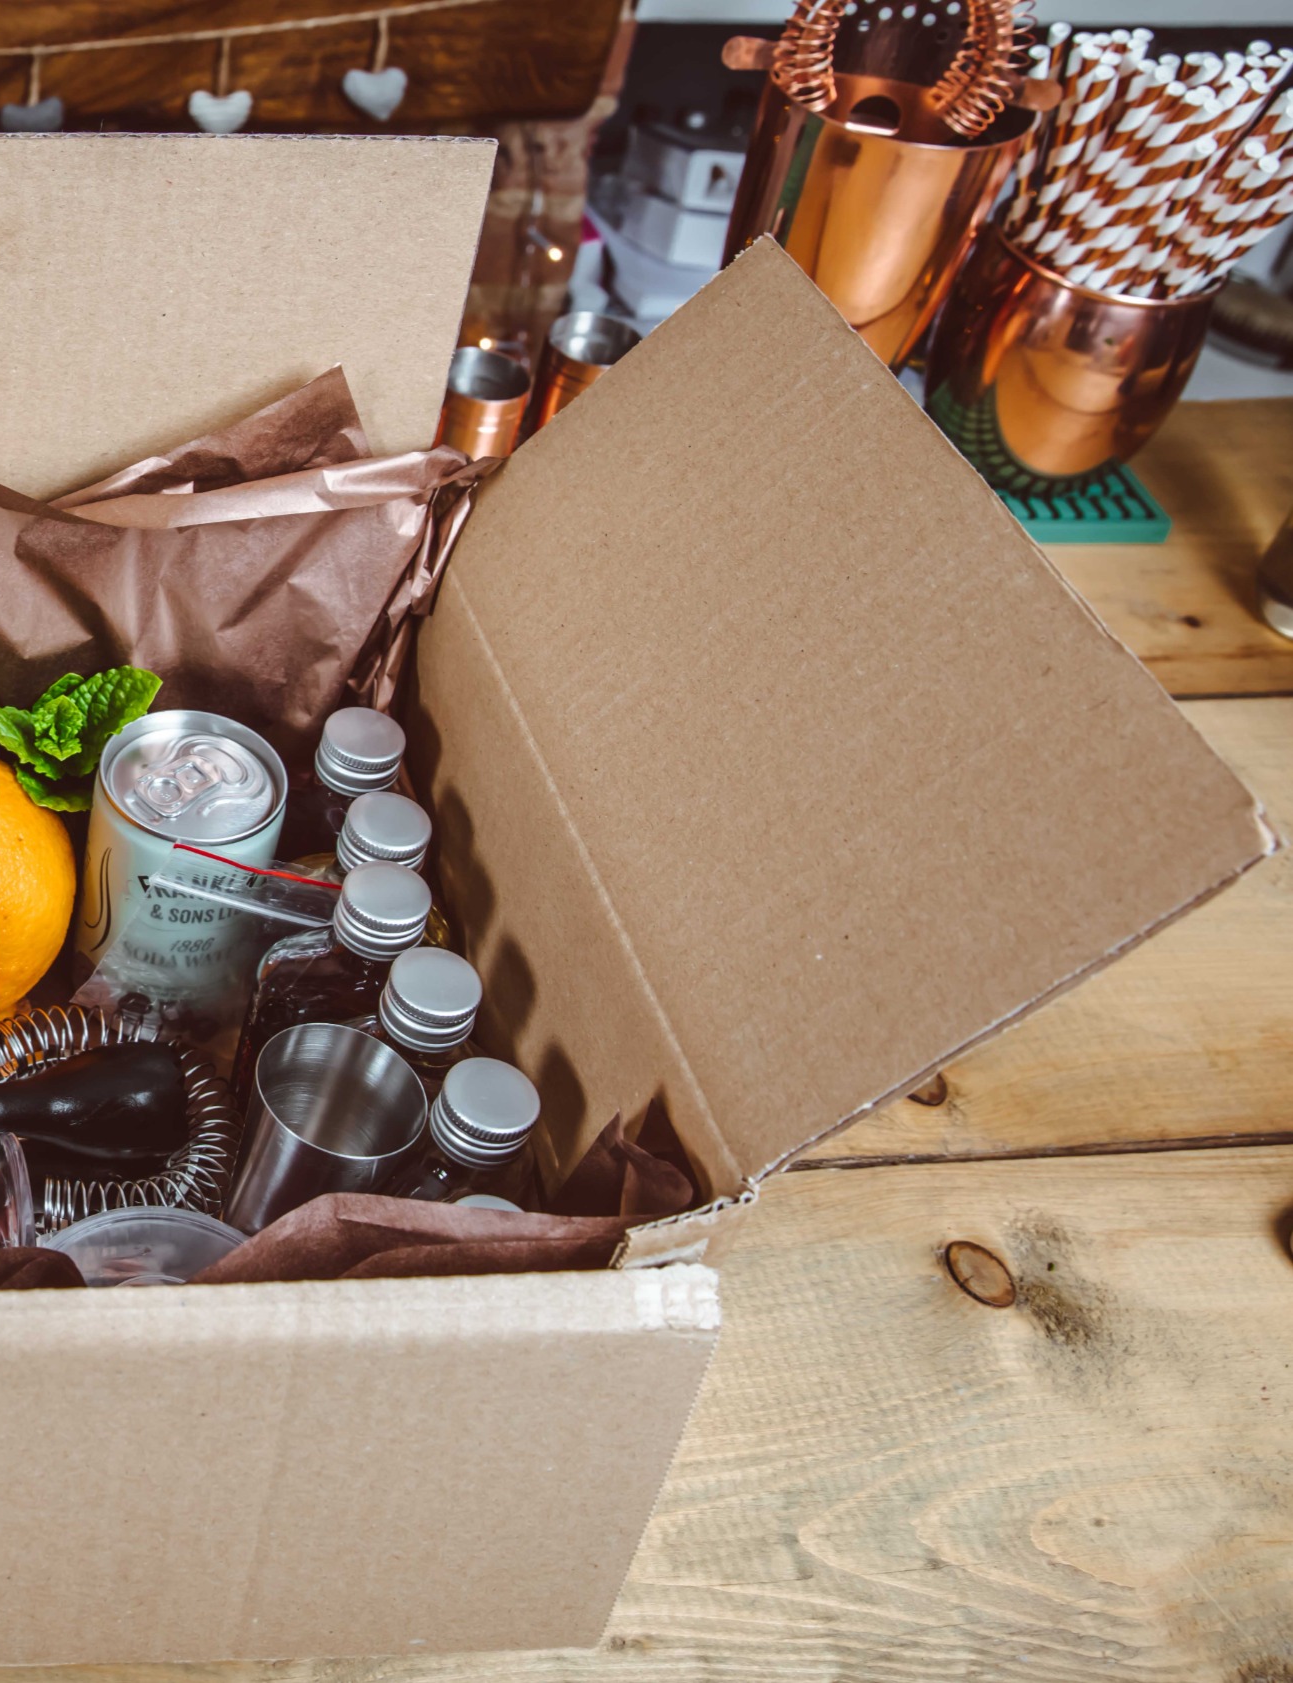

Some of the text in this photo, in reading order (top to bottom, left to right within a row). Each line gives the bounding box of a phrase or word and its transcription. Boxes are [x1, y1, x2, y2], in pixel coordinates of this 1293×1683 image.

[150, 903, 163, 920] &
[168, 908, 215, 924] SONS
[169, 937, 215, 953] 1886
